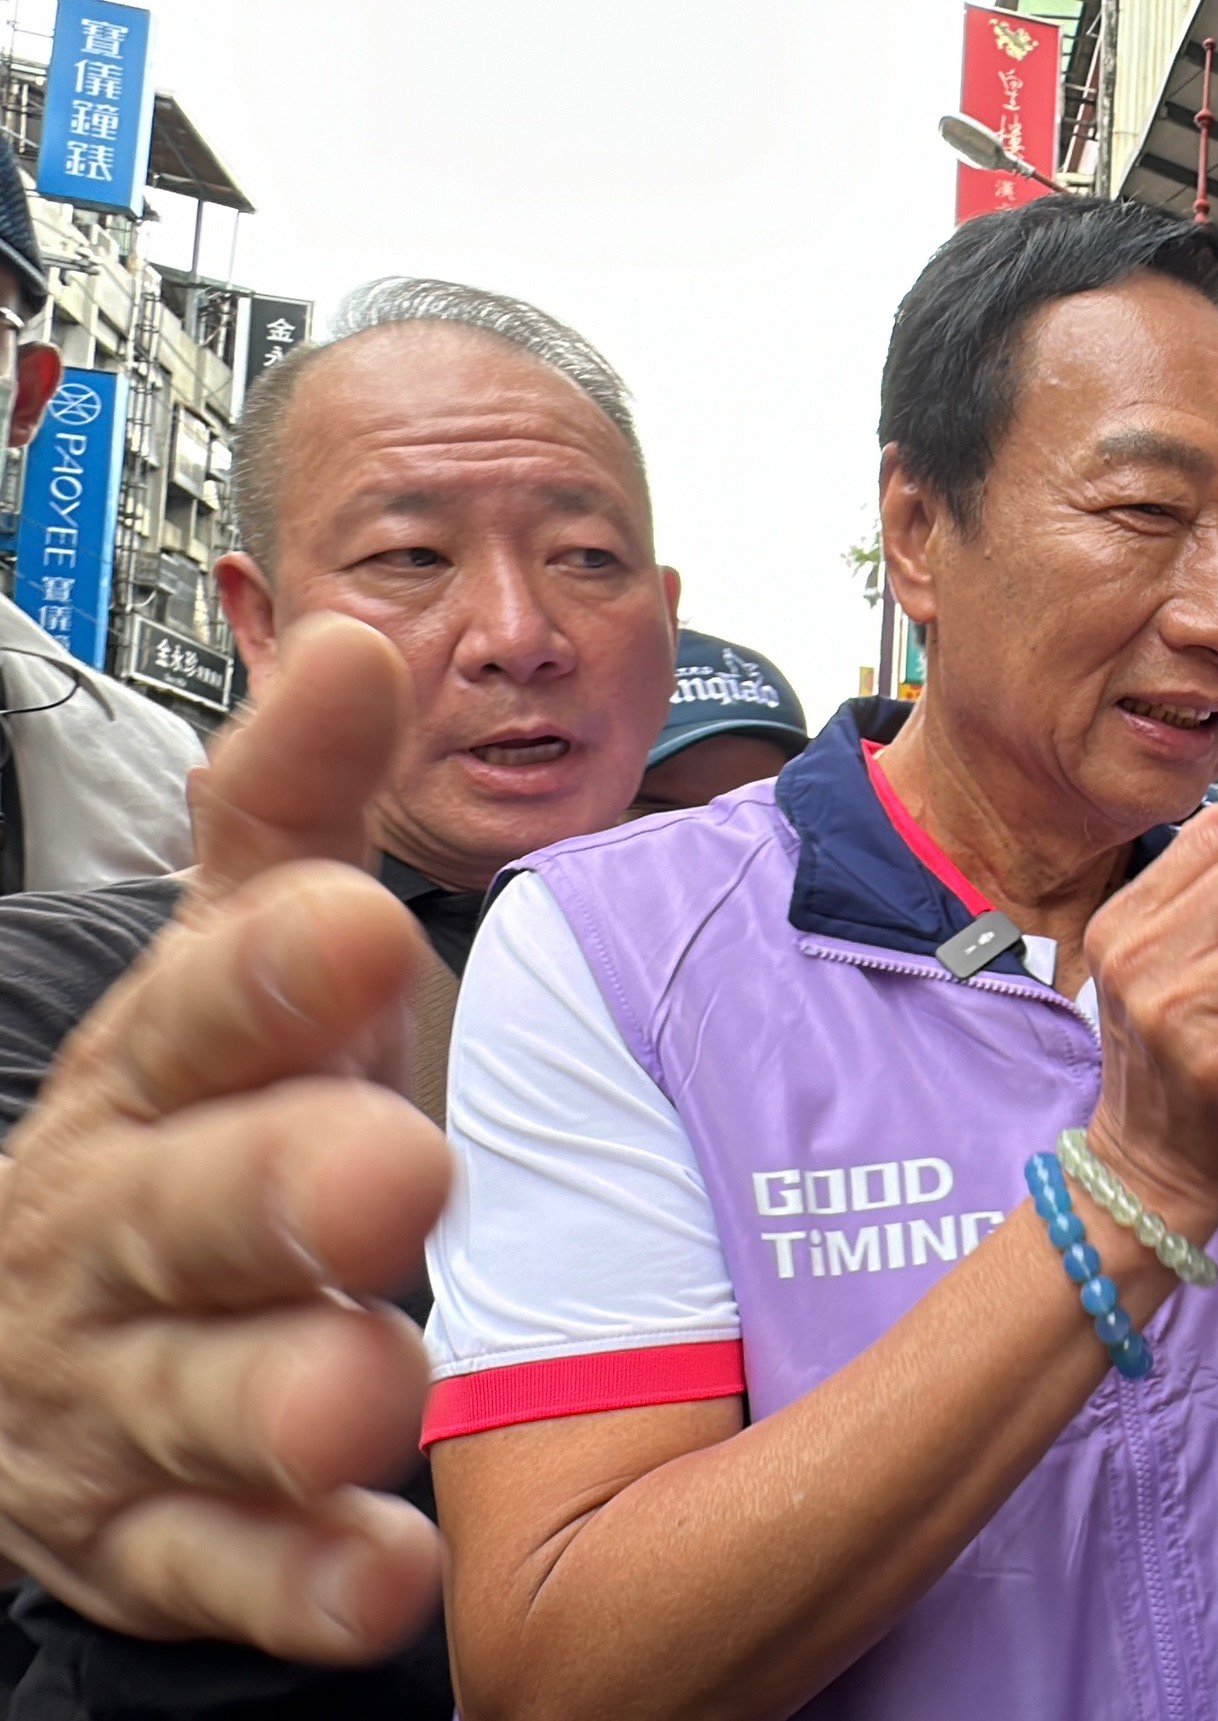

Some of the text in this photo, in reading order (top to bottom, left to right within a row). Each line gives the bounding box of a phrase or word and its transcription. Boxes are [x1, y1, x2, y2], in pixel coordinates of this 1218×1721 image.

[65, 18, 129, 182] 寶儀鐘錶
[43, 432, 87, 569] PAOYEE
[752, 1157, 954, 1216] GOOD
